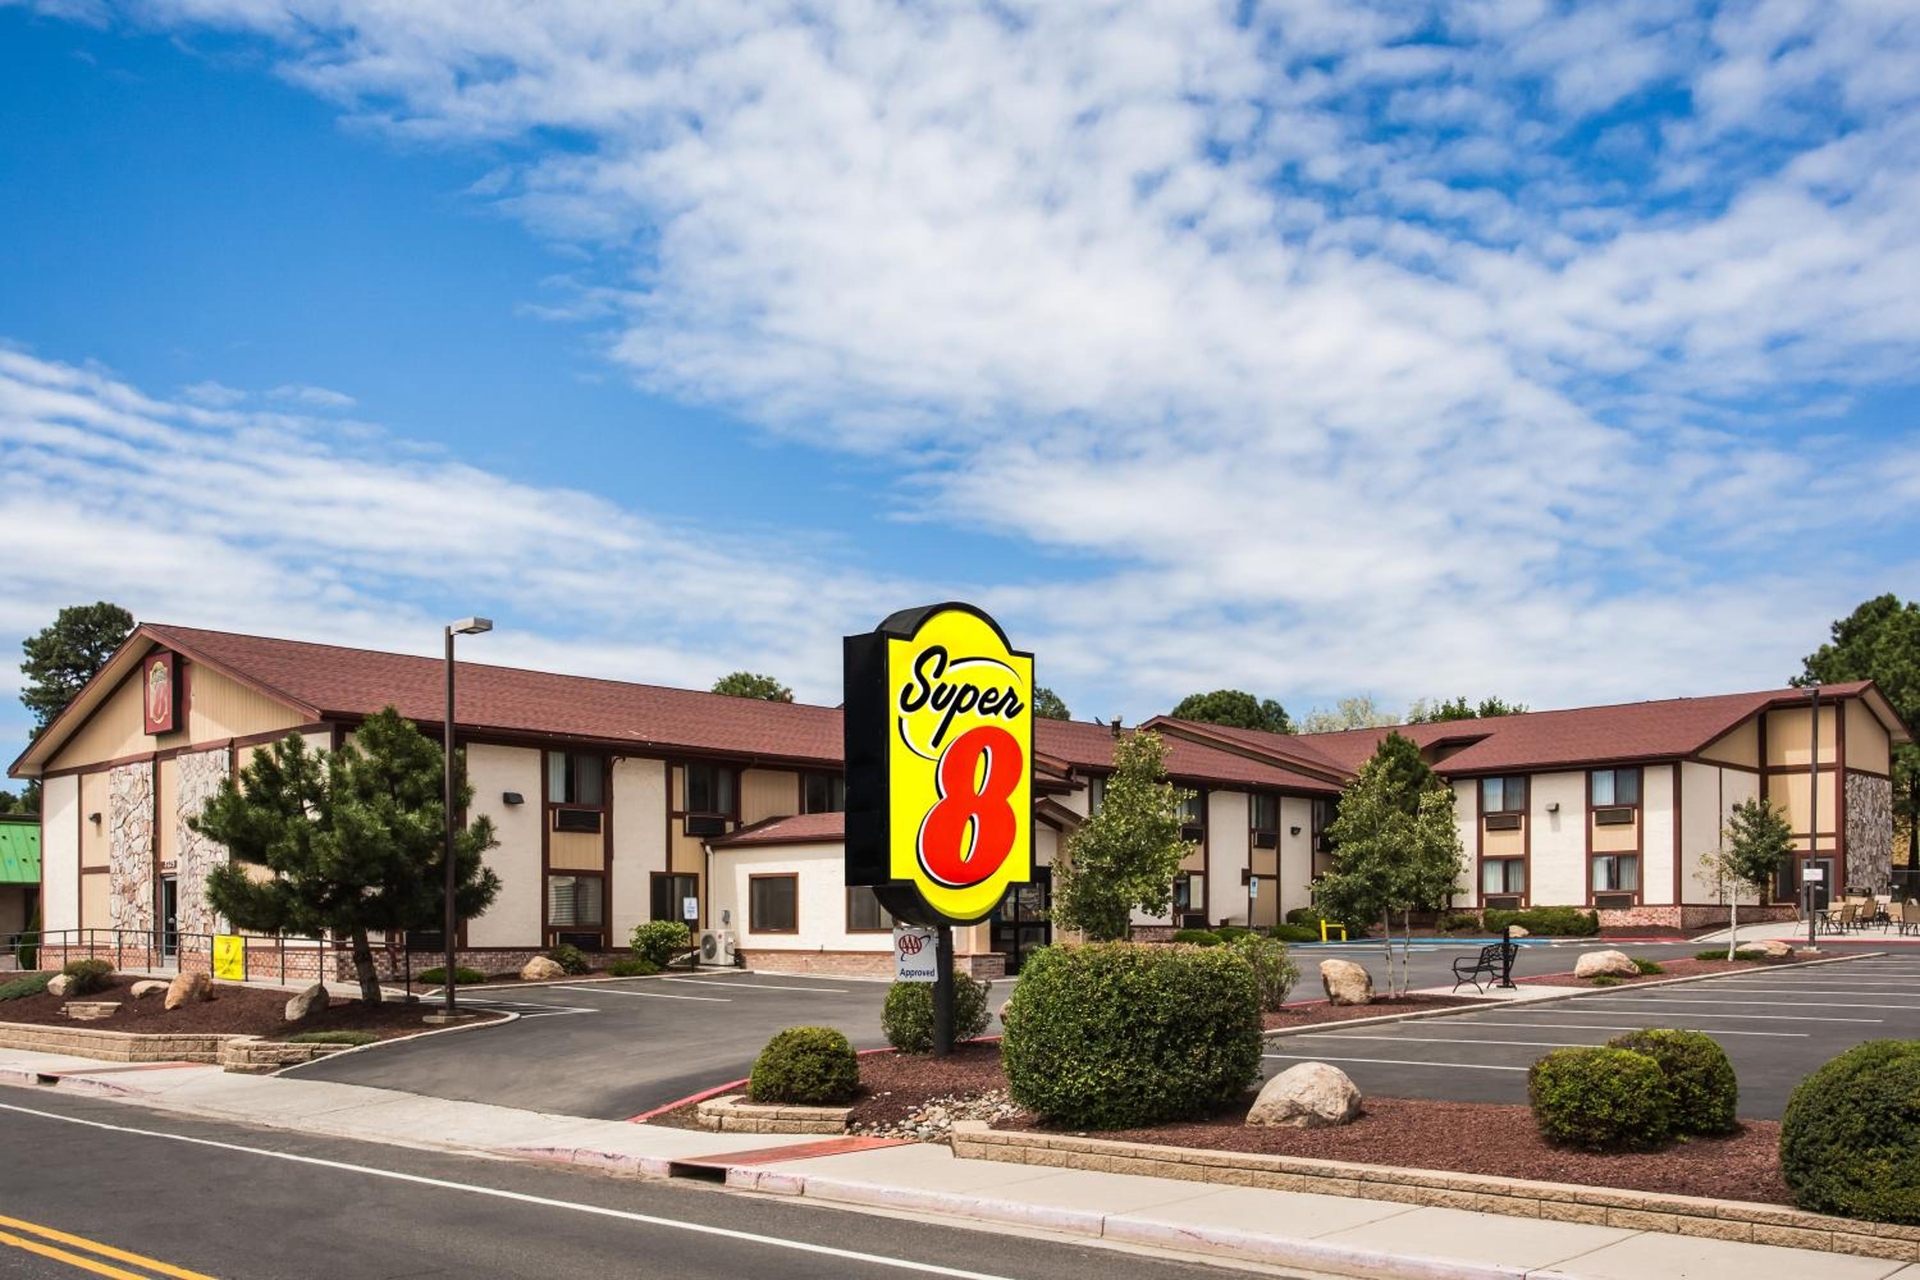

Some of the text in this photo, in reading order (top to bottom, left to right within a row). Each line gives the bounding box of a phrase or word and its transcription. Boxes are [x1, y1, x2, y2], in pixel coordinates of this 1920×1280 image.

[900, 645, 1025, 749] Super
[917, 726, 1024, 889] 8
[899, 935, 921, 954] AAA
[900, 967, 935, 978] Approved
